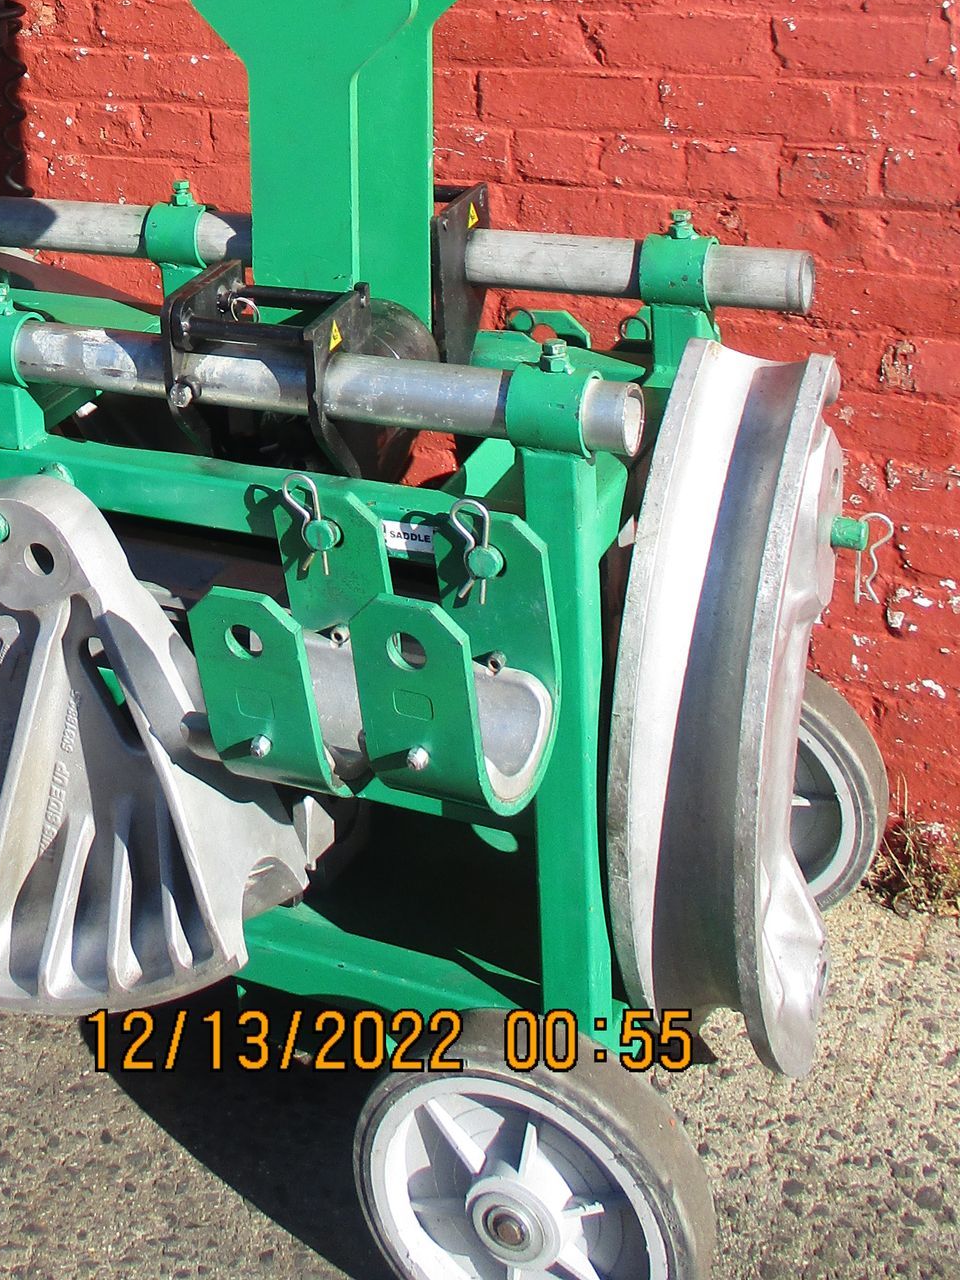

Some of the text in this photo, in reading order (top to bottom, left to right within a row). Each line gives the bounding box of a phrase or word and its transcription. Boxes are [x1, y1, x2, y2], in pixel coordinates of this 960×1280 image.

[389, 530, 431, 543] SADDLE
[52, 760, 71, 789] UP
[44, 787, 67, 827] SIDE
